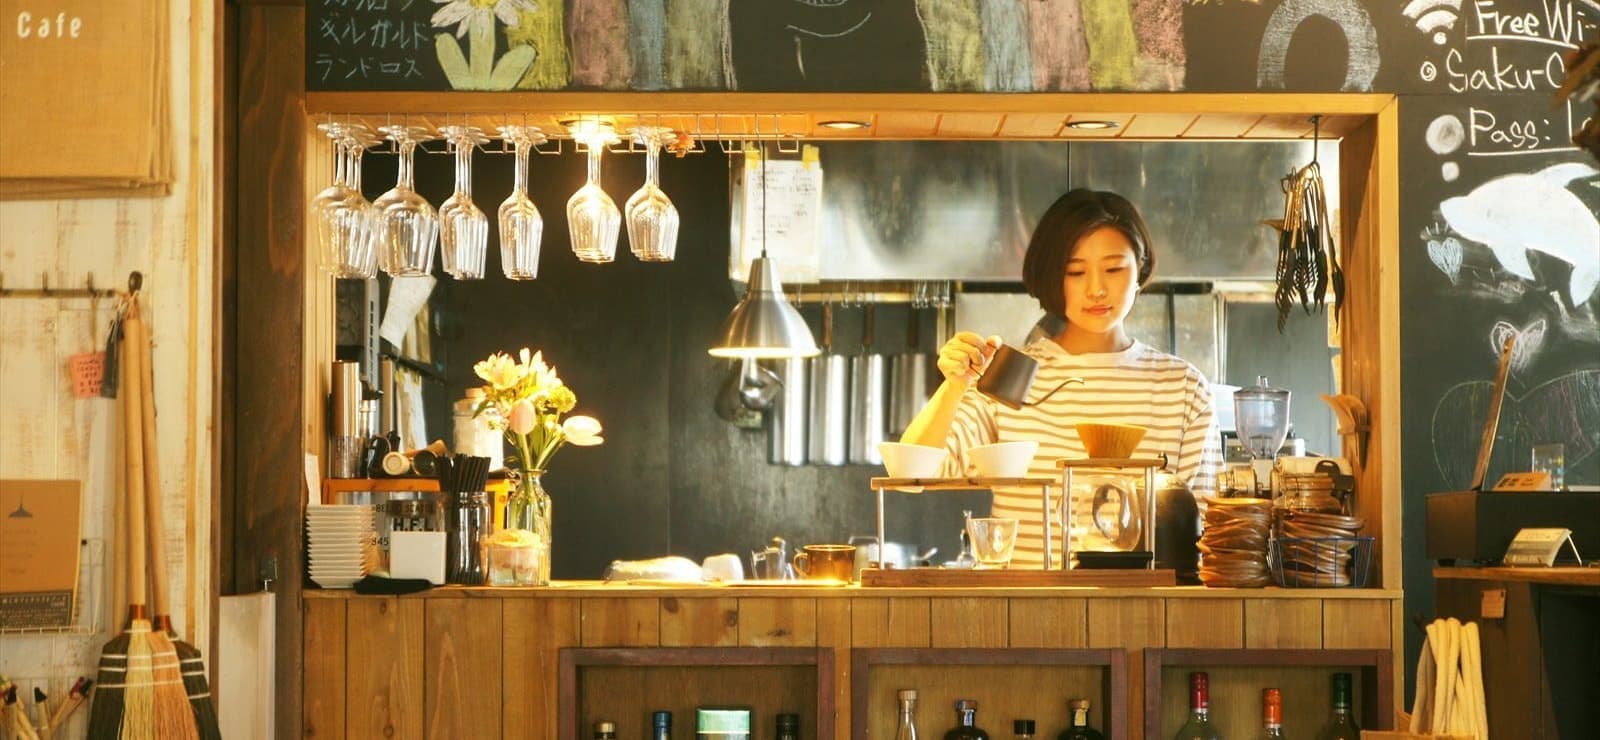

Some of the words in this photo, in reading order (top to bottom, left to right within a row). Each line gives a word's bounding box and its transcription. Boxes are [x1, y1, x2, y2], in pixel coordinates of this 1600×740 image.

[17, 11, 82, 38] Cafe
[1474, 0, 1540, 36] Free
[315, 53, 423, 81] ランドロス
[1469, 107, 1551, 149] Pass:
